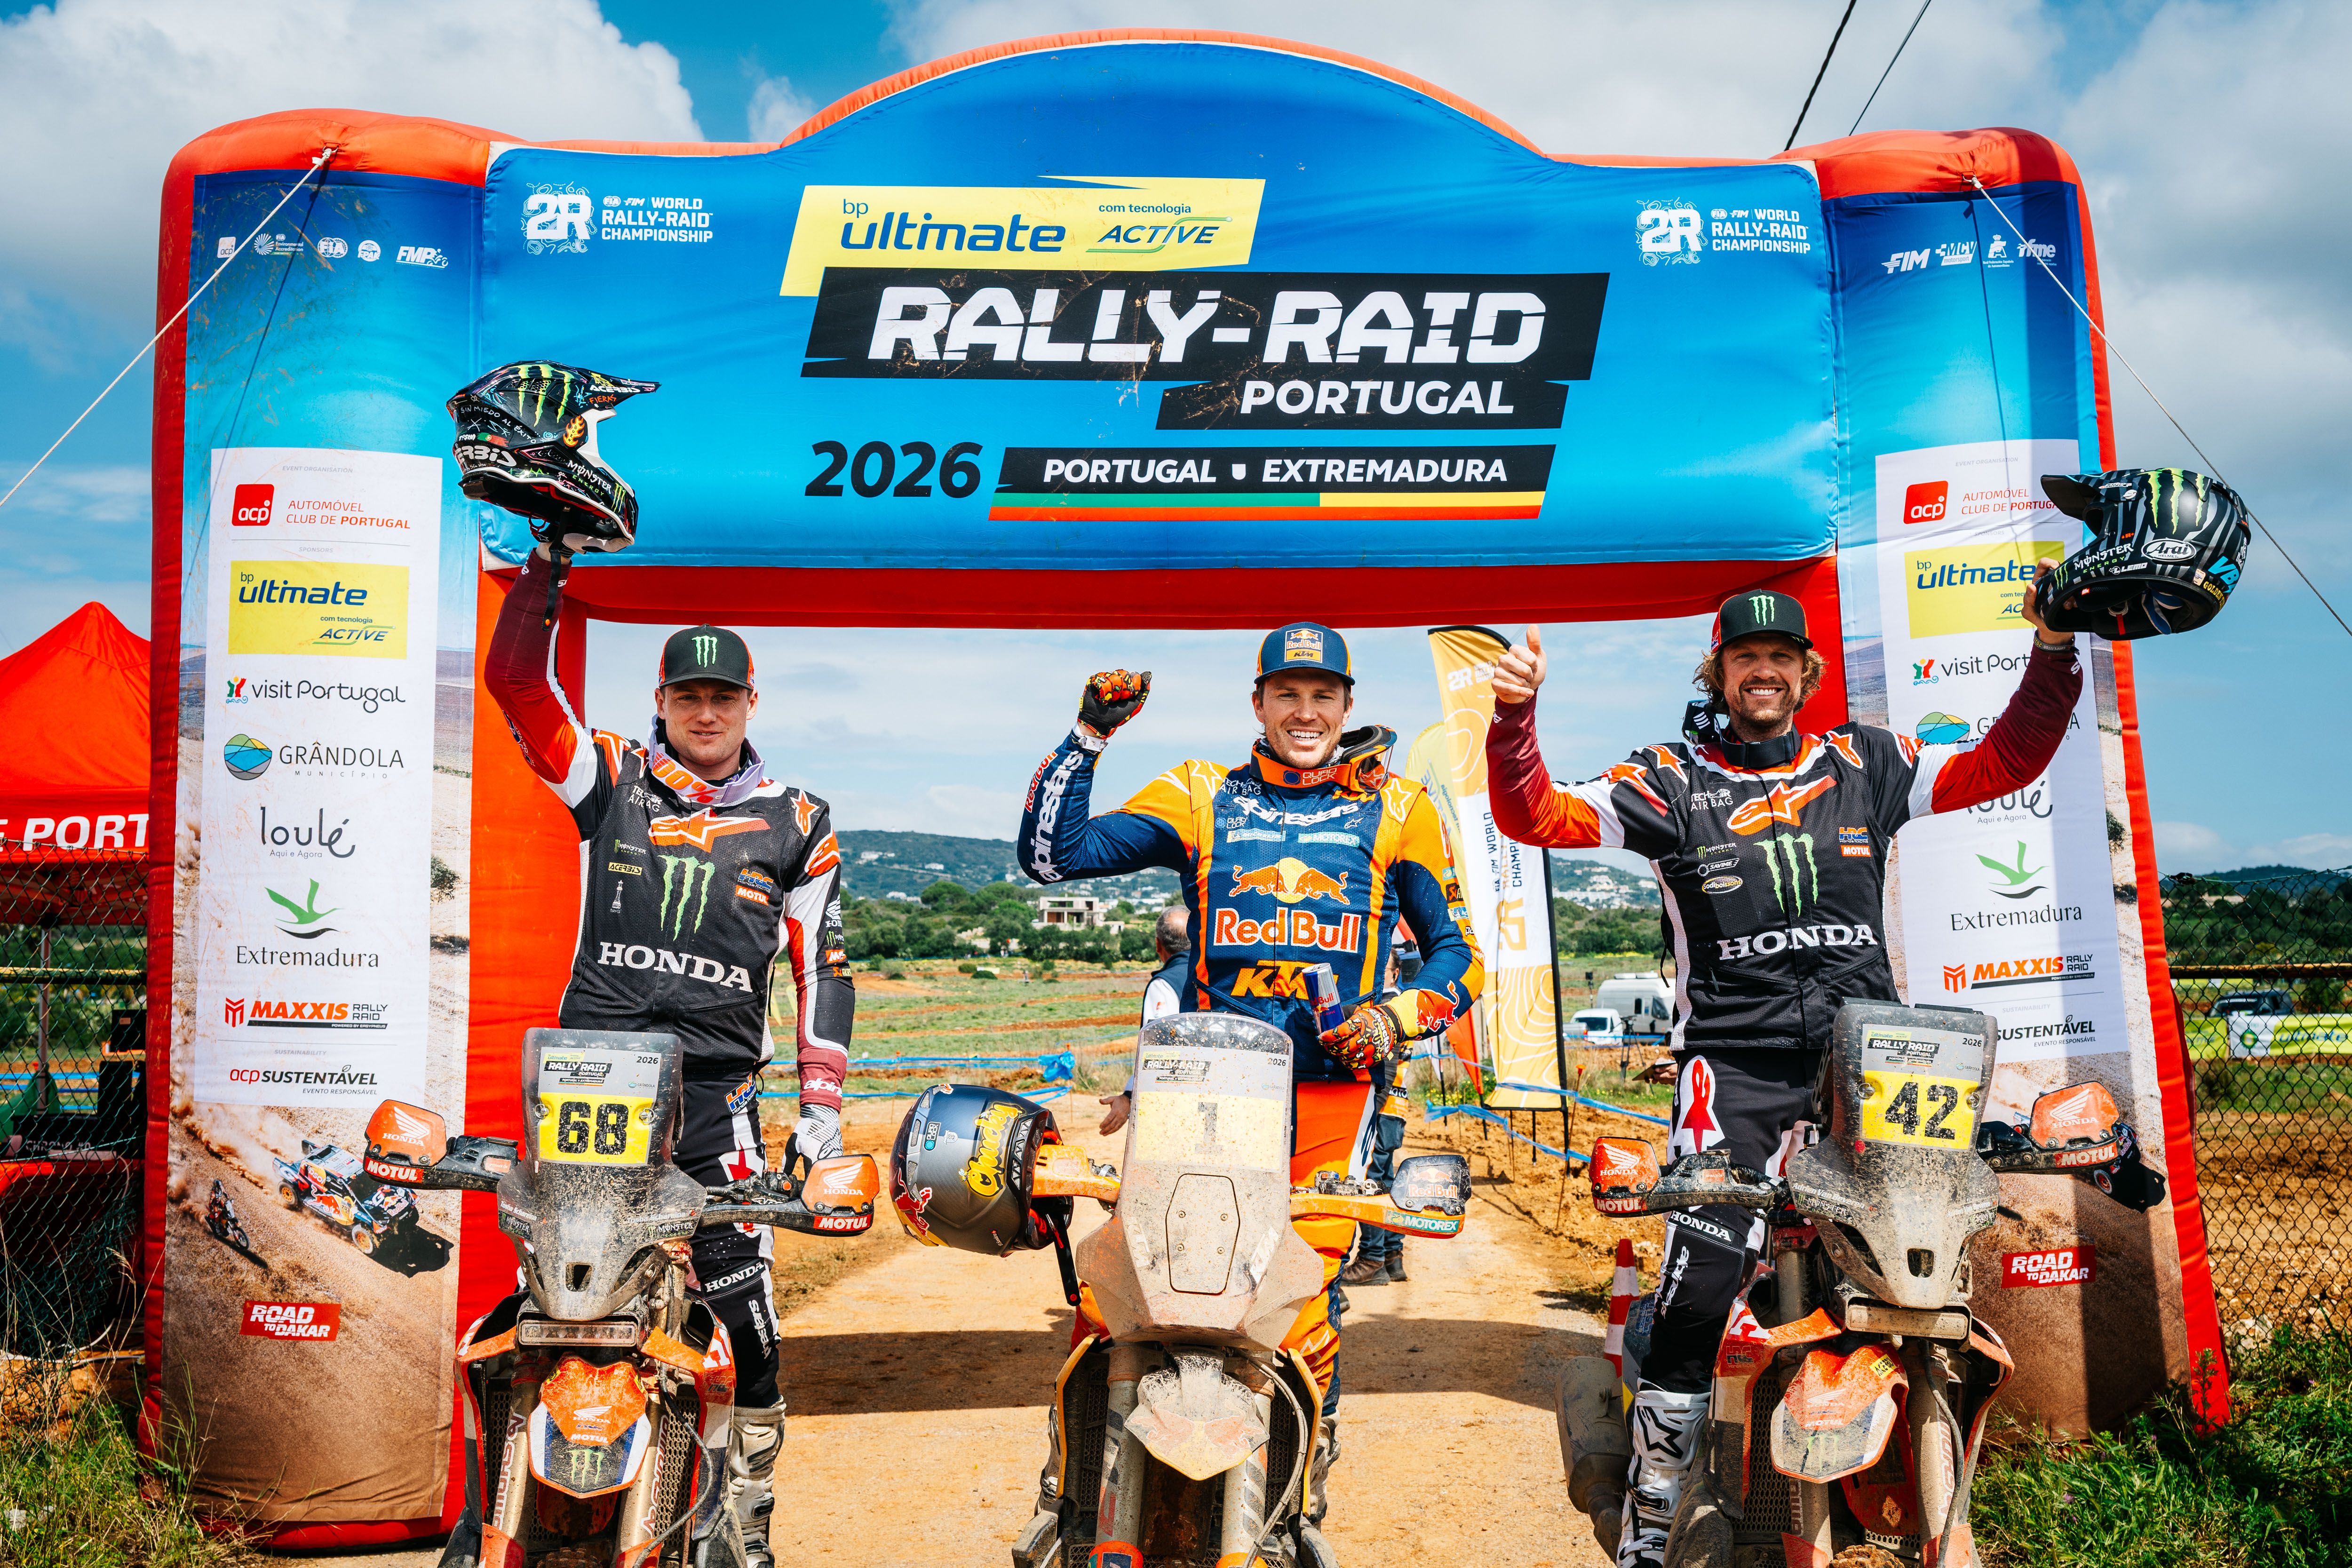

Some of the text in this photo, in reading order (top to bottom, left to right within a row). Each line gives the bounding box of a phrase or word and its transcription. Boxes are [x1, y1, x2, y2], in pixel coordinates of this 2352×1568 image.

[603, 196, 702, 210] FIA FIM WORLD
[842, 199, 869, 219] bp
[1098, 203, 1192, 216] com tecnologia
[1712, 208, 1799, 223] FIA FIM WORLD
[602, 228, 713, 242] CHAMPIONSHIP
[841, 212, 1066, 252] ultimate
[1098, 224, 1220, 246] ACTIVE
[220, 248, 233, 257] acp
[1712, 239, 1811, 254] CHAMPIONSHIP
[397, 246, 435, 263] FMP
[1882, 248, 1931, 274] FIM
[868, 287, 1546, 364] RALLY-RAID
[1241, 381, 1513, 414] PORTUGAL
[474, 406, 500, 417] MIEDO
[1976, 457, 2018, 465] ORGANISATION
[568, 460, 612, 494] MONSTER
[804, 441, 983, 498] 2026
[1043, 459, 1507, 483] PORTUGAL EXTREMADURA
[572, 474, 604, 496] ENERGY
[1963, 488, 2029, 502] AUTOMÓVEL
[288, 500, 364, 512] AUTOMÓVEL
[1911, 502, 1944, 519] acp
[1961, 503, 2007, 515] CLUB DE
[238, 507, 270, 524] acp
[286, 514, 410, 529] CLUB DE PORTUGAL
[2146, 541, 2189, 556] Arai
[2074, 543, 2134, 570] MONSTER
[1917, 560, 1931, 571] bp
[2083, 556, 2125, 573] ENERGY
[241, 572, 254, 584] bp
[1917, 559, 2036, 590] ultimate
[239, 580, 367, 606] ultimate
[319, 629, 389, 641] ACTIVE
[1304, 640, 1321, 650] Bull
[1941, 657, 1983, 677] visit
[252, 680, 405, 713] visit Portugal
[279, 740, 404, 768] GRÂNDOLA
[294, 770, 388, 779] MUNICÍPIO
[1303, 768, 1337, 779] QUAD
[1303, 774, 1335, 785] LOCK
[1032, 750, 1083, 882] alpinestars
[2004, 814, 2026, 823] Agora
[261, 806, 355, 858] loulé
[1312, 834, 1357, 845] MOTOREX
[1484, 812, 1497, 854] WORLD
[1839, 827, 1868, 840] HRC
[270, 849, 323, 859] Aqui Agora
[619, 844, 646, 854] MONSTER
[1706, 843, 1737, 852] MONSTER
[1843, 846, 1870, 856] MOTUL
[609, 864, 641, 874] ACERBIS
[1703, 880, 1741, 889] Sodiboissons
[737, 888, 768, 904] MOTUL
[1951, 904, 2082, 931] Extremadura
[1214, 908, 1362, 953] Red Bull
[1717, 924, 1878, 961] HONDA
[237, 946, 379, 968] Extremadura
[598, 941, 753, 993] HONDA
[1973, 954, 2093, 981] MAXXIS RALLY
[2067, 963, 2089, 971] RAID
[1319, 993, 1334, 1004] Bull
[250, 1001, 388, 1020] MAXXIS RALLY
[2002, 1004, 2050, 1013] SUSTAINABILITY
[352, 1012, 380, 1021] RAID
[1963, 1038, 1982, 1047] 2026
[2058, 1036, 2096, 1045] RESPONSÁVEL
[1268, 1058, 1287, 1067] 2026
[230, 1069, 260, 1084] acp
[1885, 1082, 1958, 1139] 42
[557, 1101, 628, 1155] 68
[1195, 1102, 1224, 1154] 1
[2053, 1117, 2098, 1128] HONDA
[382, 1132, 425, 1146] HONDA
[2061, 1146, 2115, 1166] MOTUL
[367, 1160, 418, 1181] MOTUL
[1408, 1184, 1457, 1199] Red Bull
[1793, 1182, 1818, 1196] Adrien
[1597, 1200, 1641, 1211] MOTUL
[506, 1217, 530, 1233] MONSTER
[658, 1222, 692, 1233] MONSTER
[819, 1217, 868, 1229] MOTUL
[1404, 1215, 1458, 1232] MOTOREX
[1671, 1210, 1732, 1242] HONDA
[2011, 1252, 2073, 1274] ROAD
[705, 1261, 764, 1292] HONDA
[2039, 1267, 2089, 1283] DAKAR
[250, 1305, 314, 1323] ROAD
[264, 1324, 330, 1337] TO DAKAR
[570, 1433, 609, 1443] MOTUL
